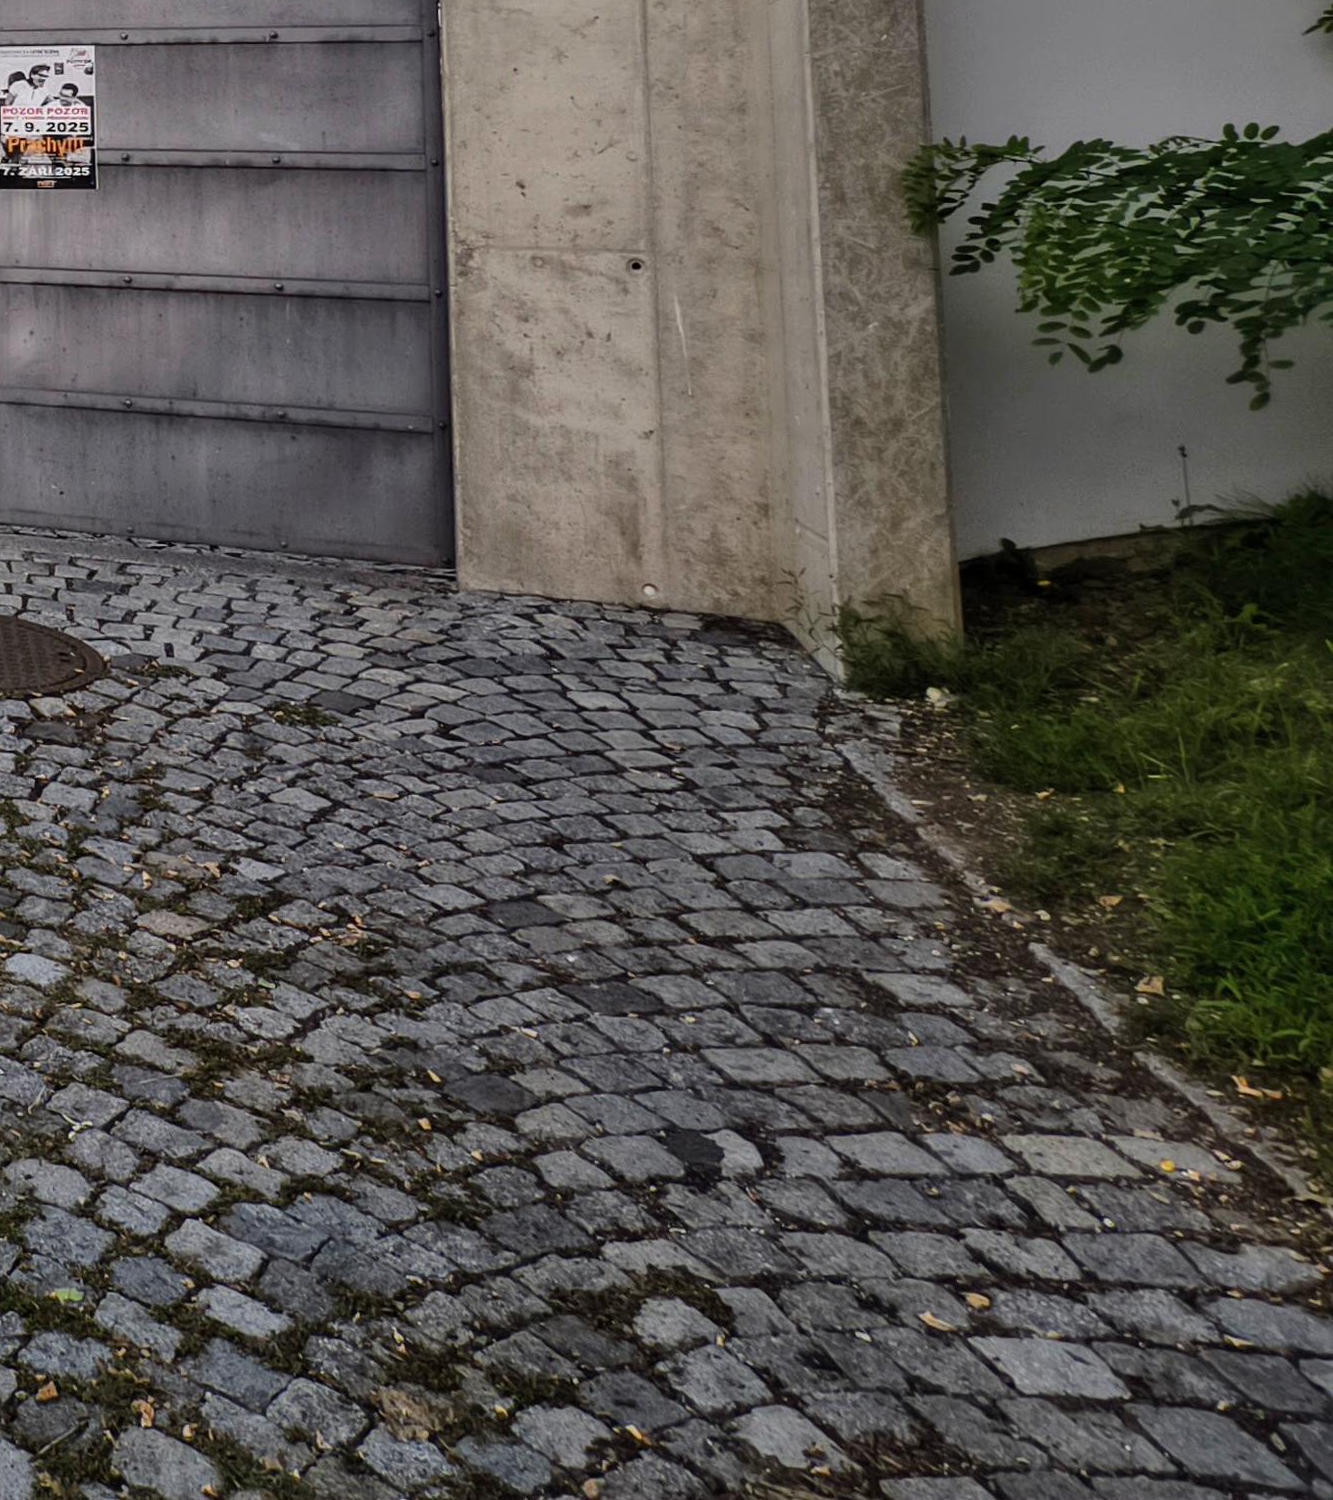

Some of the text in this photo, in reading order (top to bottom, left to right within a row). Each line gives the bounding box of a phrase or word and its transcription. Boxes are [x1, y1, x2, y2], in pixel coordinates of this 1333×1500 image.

[2, 107, 89, 115] POZOR POZOR
[3, 122, 89, 132] 7. 9. 2025
[2, 167, 15, 176] 7.
[55, 167, 90, 176] 2025
